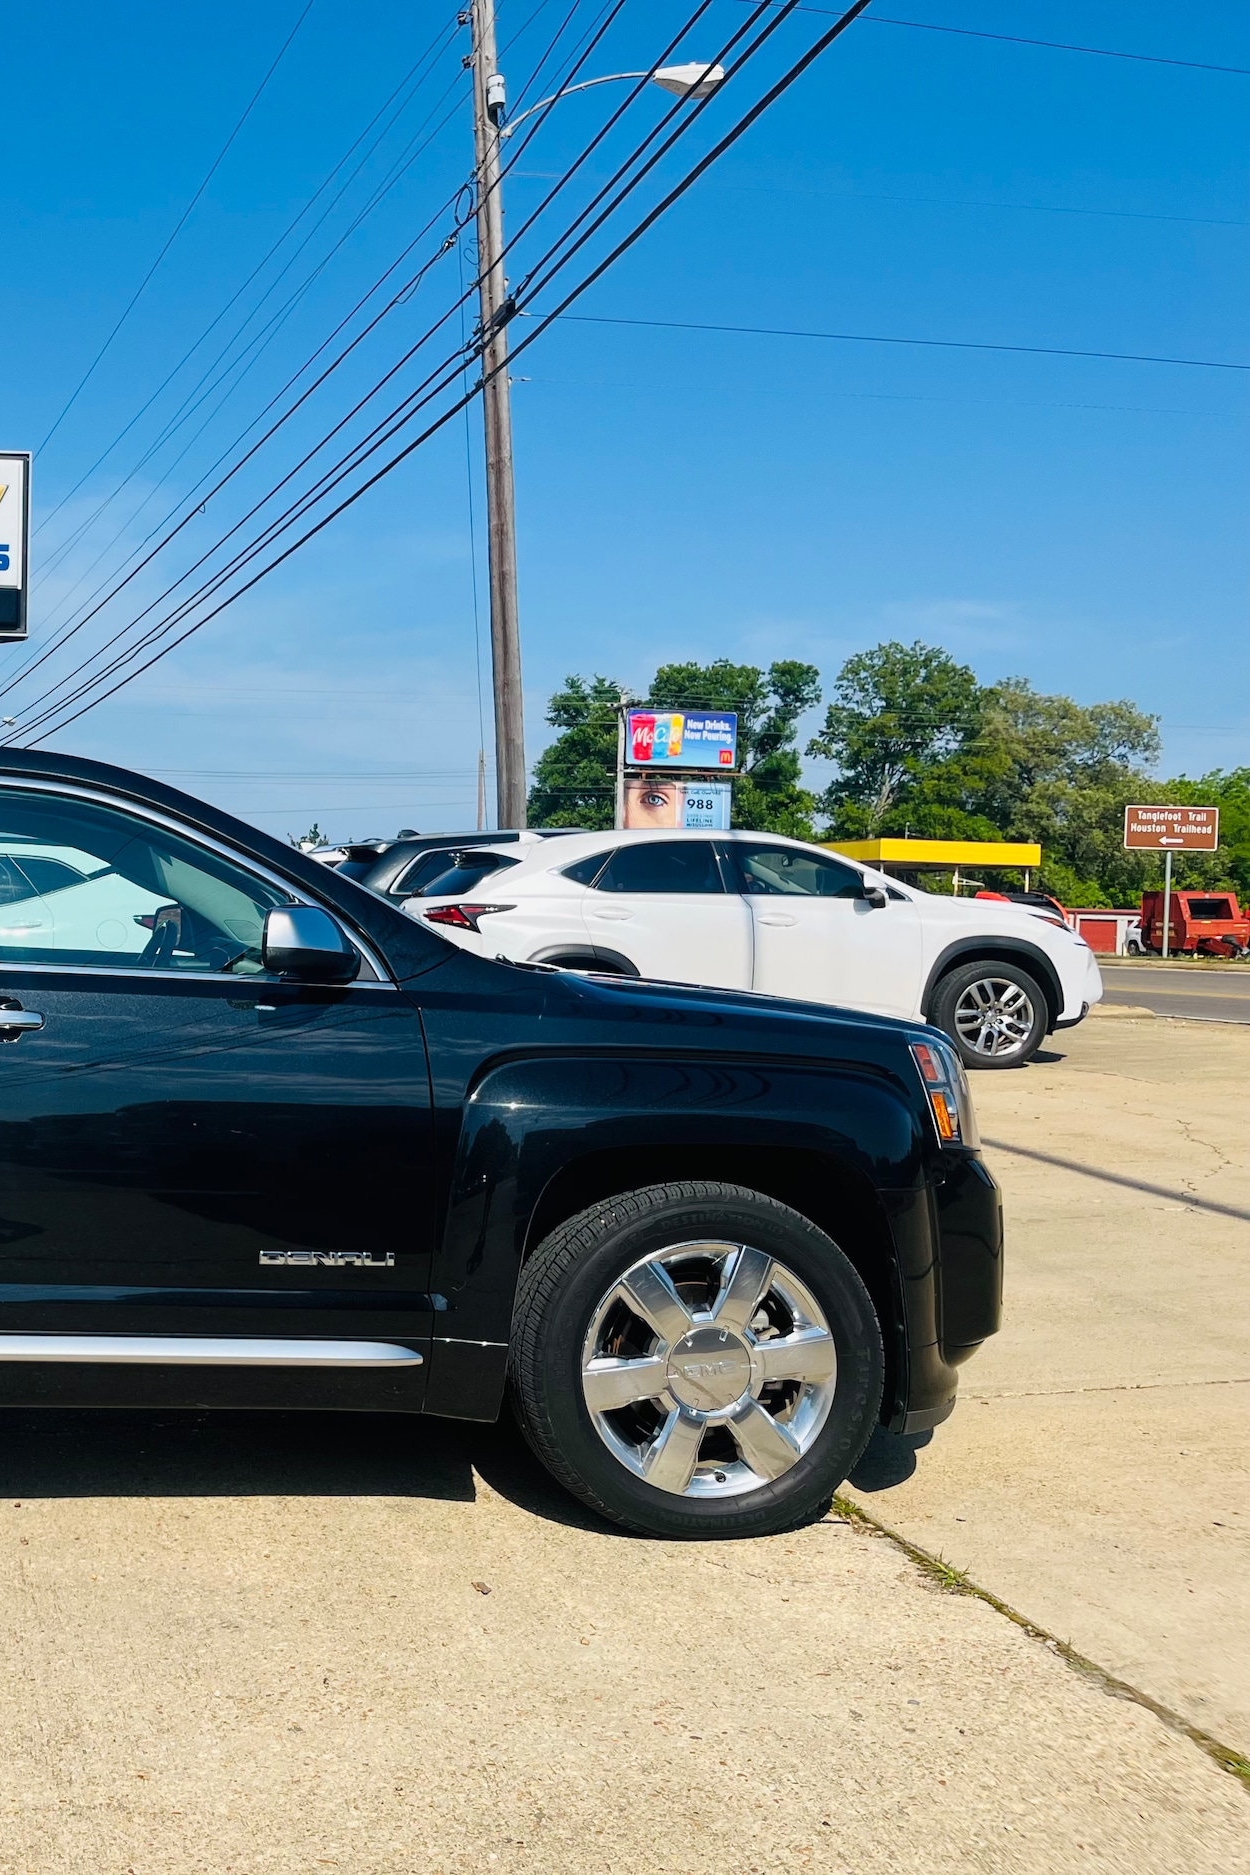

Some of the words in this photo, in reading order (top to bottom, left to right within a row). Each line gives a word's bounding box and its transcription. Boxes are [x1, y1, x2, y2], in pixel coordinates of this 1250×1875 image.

[687, 719, 704, 730] New
[705, 720, 732, 731] Drinks.
[684, 729, 702, 740] Now
[702, 730, 734, 744] Pouring.
[687, 798, 714, 810] 988
[1137, 810, 1182, 822] Tanglefoot
[1188, 812, 1207, 822] Trail
[1130, 823, 1167, 833] Houston
[1173, 824, 1212, 834] Trailhead
[258, 1250, 396, 1267] DENALI
[683, 1360, 736, 1378] GMC
